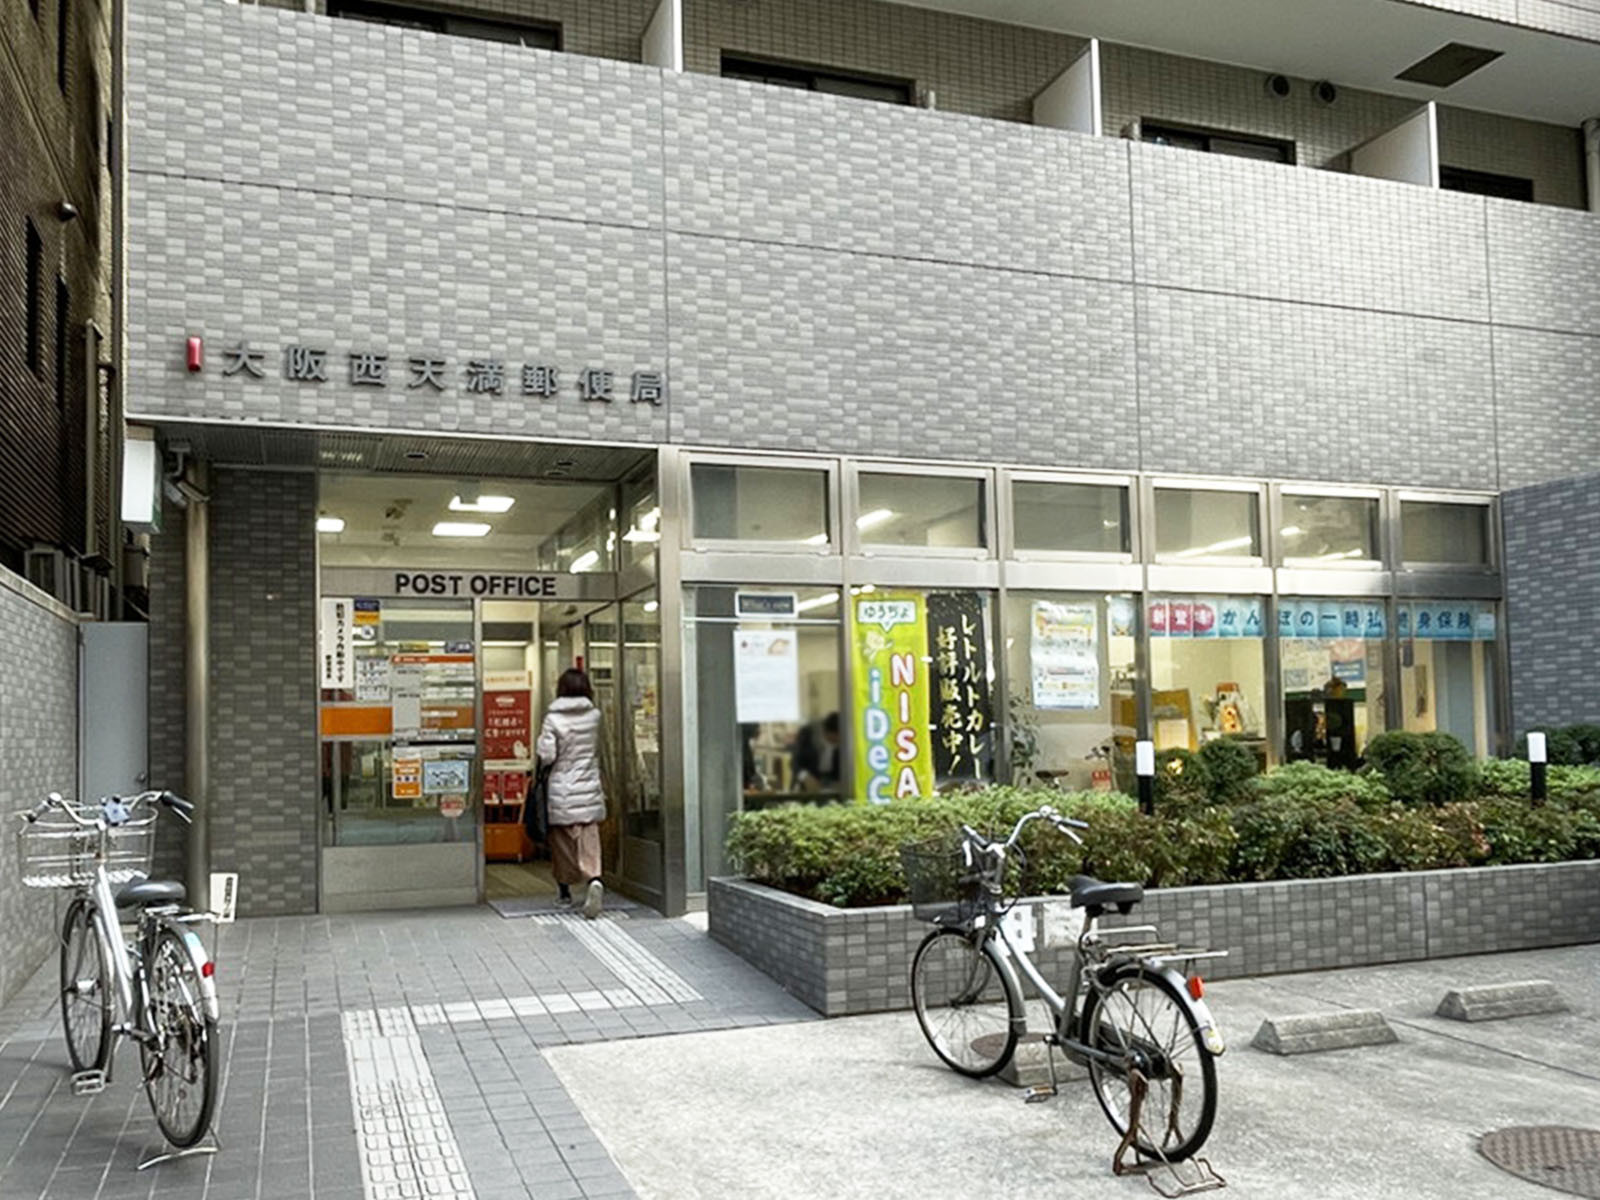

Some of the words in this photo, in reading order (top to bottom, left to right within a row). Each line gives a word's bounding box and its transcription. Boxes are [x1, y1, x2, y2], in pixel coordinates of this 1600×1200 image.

[223, 341, 664, 404] 大阪西天満郵便局
[395, 573, 462, 595] POST
[470, 575, 556, 596] OFFICE
[864, 604, 910, 619] ゆうちょ
[890, 652, 921, 800] NISA
[961, 613, 985, 780] レトルトカレー
